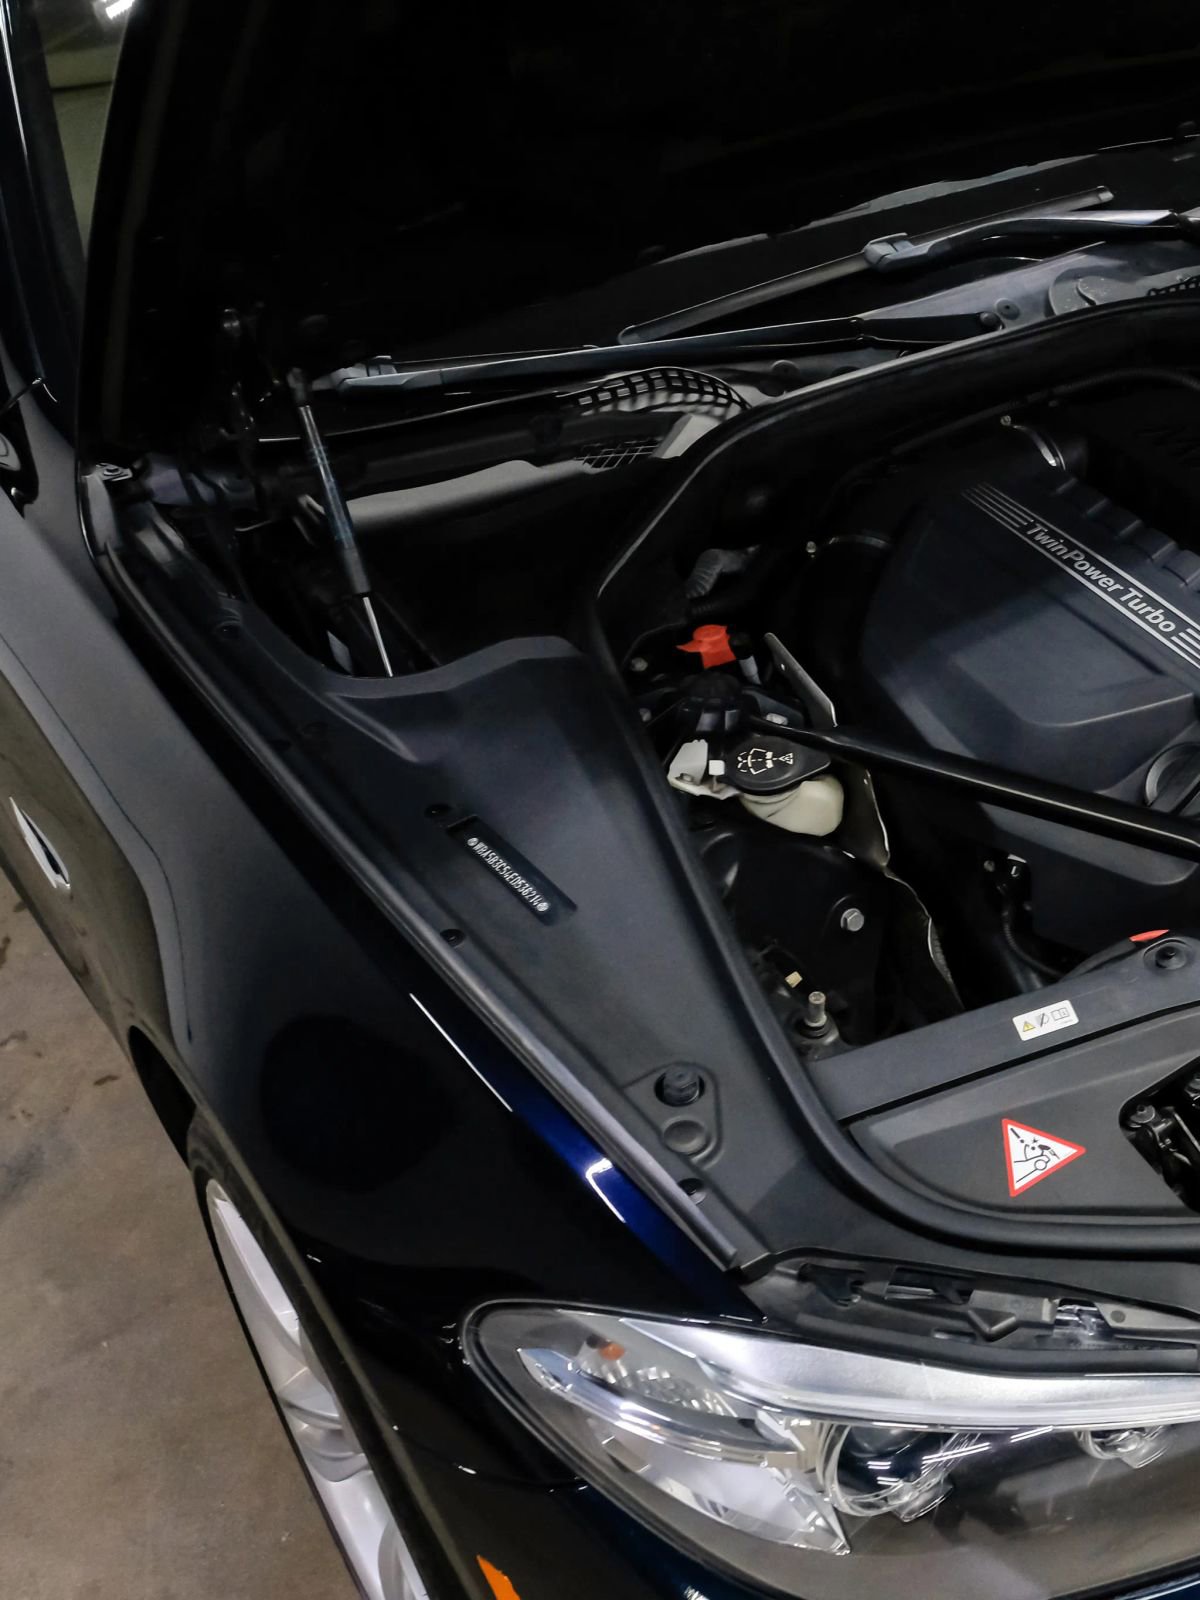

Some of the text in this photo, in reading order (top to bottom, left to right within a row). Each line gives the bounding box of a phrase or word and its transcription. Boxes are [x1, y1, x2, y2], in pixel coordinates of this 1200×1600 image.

[1026, 522, 1176, 633] TwinPower Turbo
[472, 841, 543, 907] WBA5B3C54ED536214
